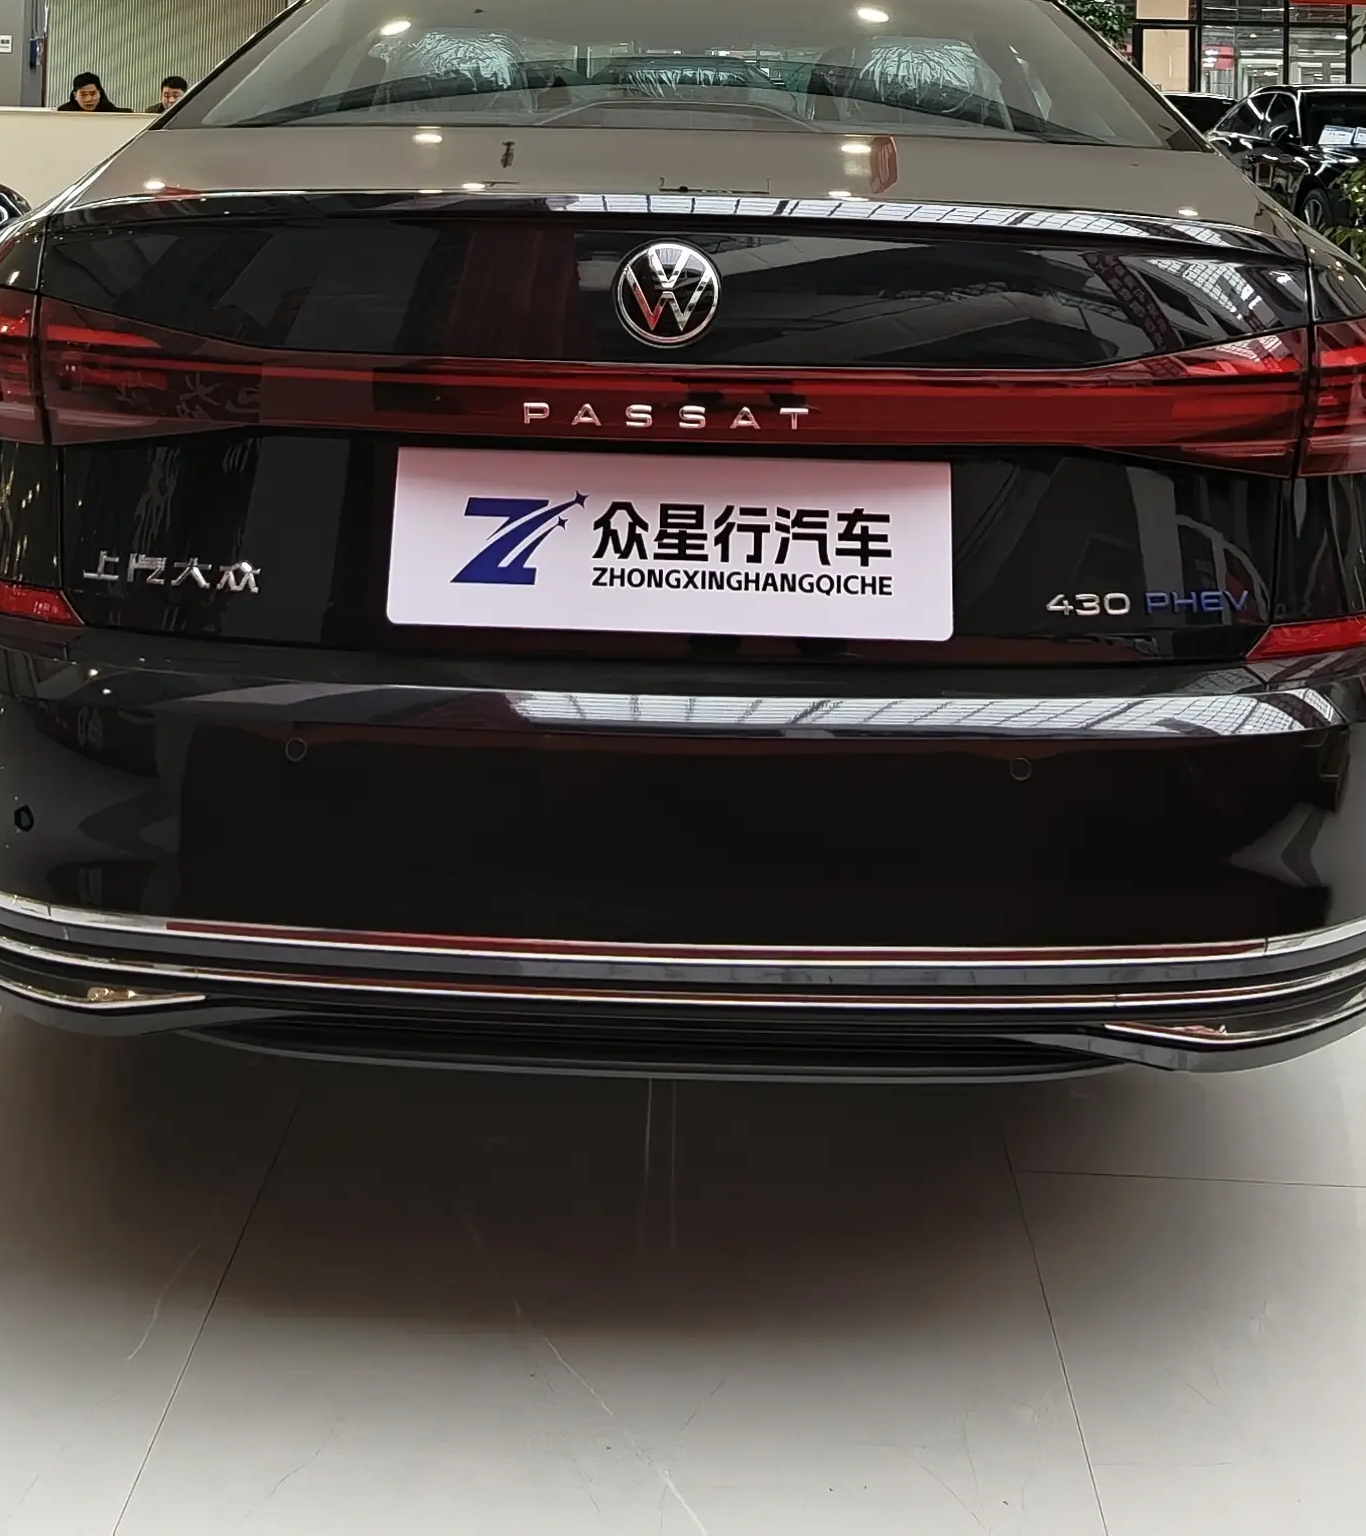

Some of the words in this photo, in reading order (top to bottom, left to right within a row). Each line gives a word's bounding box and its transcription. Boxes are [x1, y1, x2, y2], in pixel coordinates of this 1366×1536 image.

[523, 401, 810, 430] PASSAT
[592, 500, 892, 567] 众星行汽车
[83, 549, 261, 594] 上汽大众
[592, 566, 893, 596] ZHONGXINGHANGQICHE
[1045, 592, 1131, 616] 430
[1145, 591, 1249, 613] PHEV
